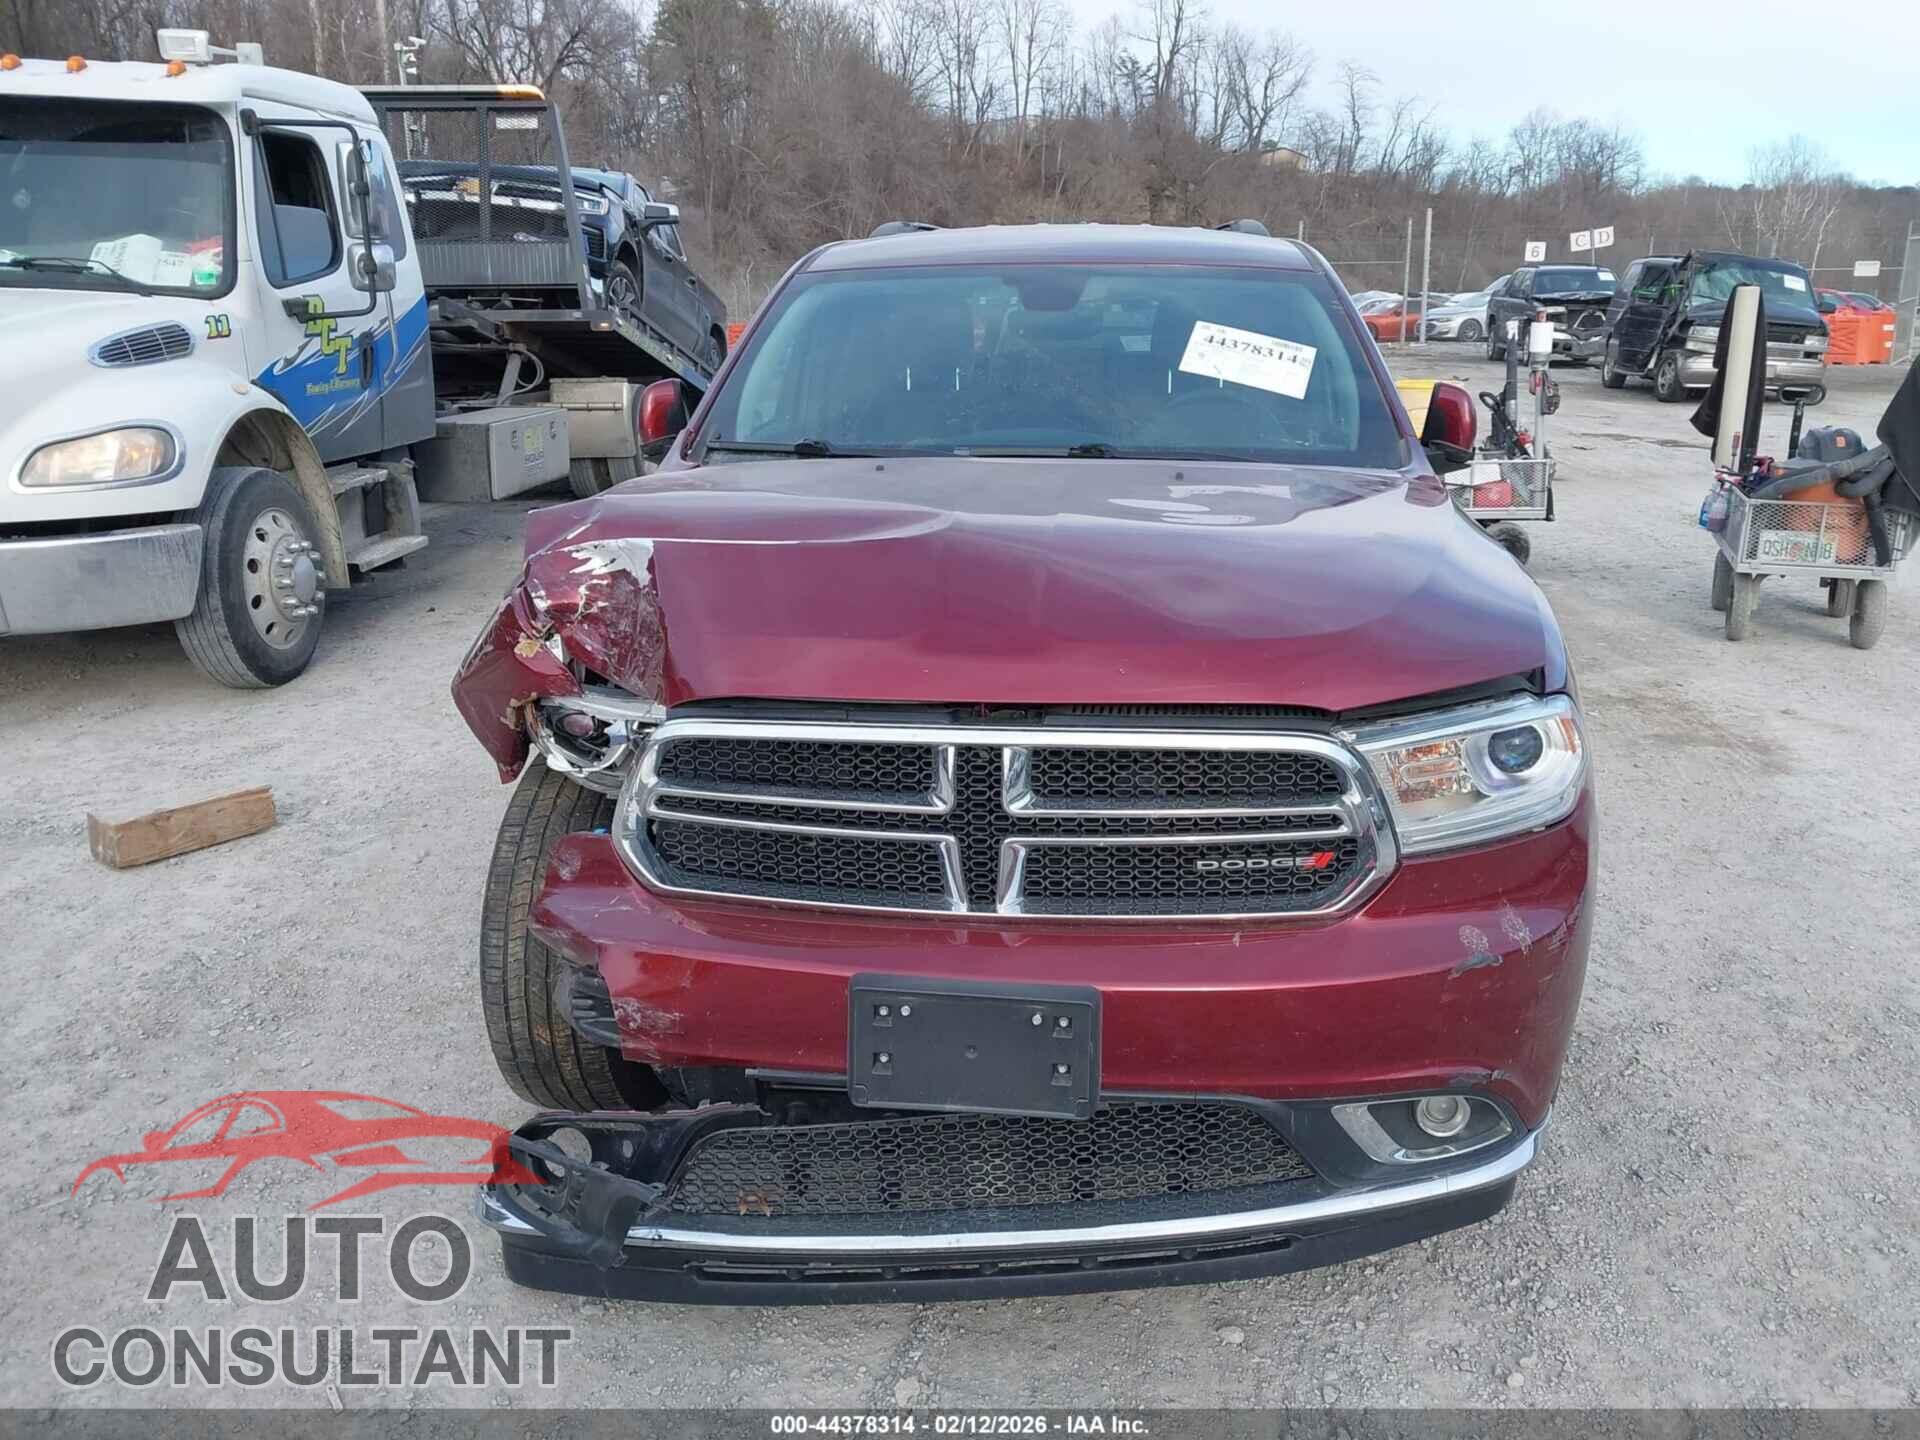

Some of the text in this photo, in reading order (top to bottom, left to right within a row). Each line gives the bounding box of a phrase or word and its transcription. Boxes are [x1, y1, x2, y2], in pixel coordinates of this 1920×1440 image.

[1575, 234, 1589, 248] C
[1599, 230, 1610, 244] D
[1531, 246, 1540, 258] 6
[205, 314, 231, 339] 11
[1203, 334, 1298, 364] 44378314
[1196, 857, 1317, 870] DODGE
